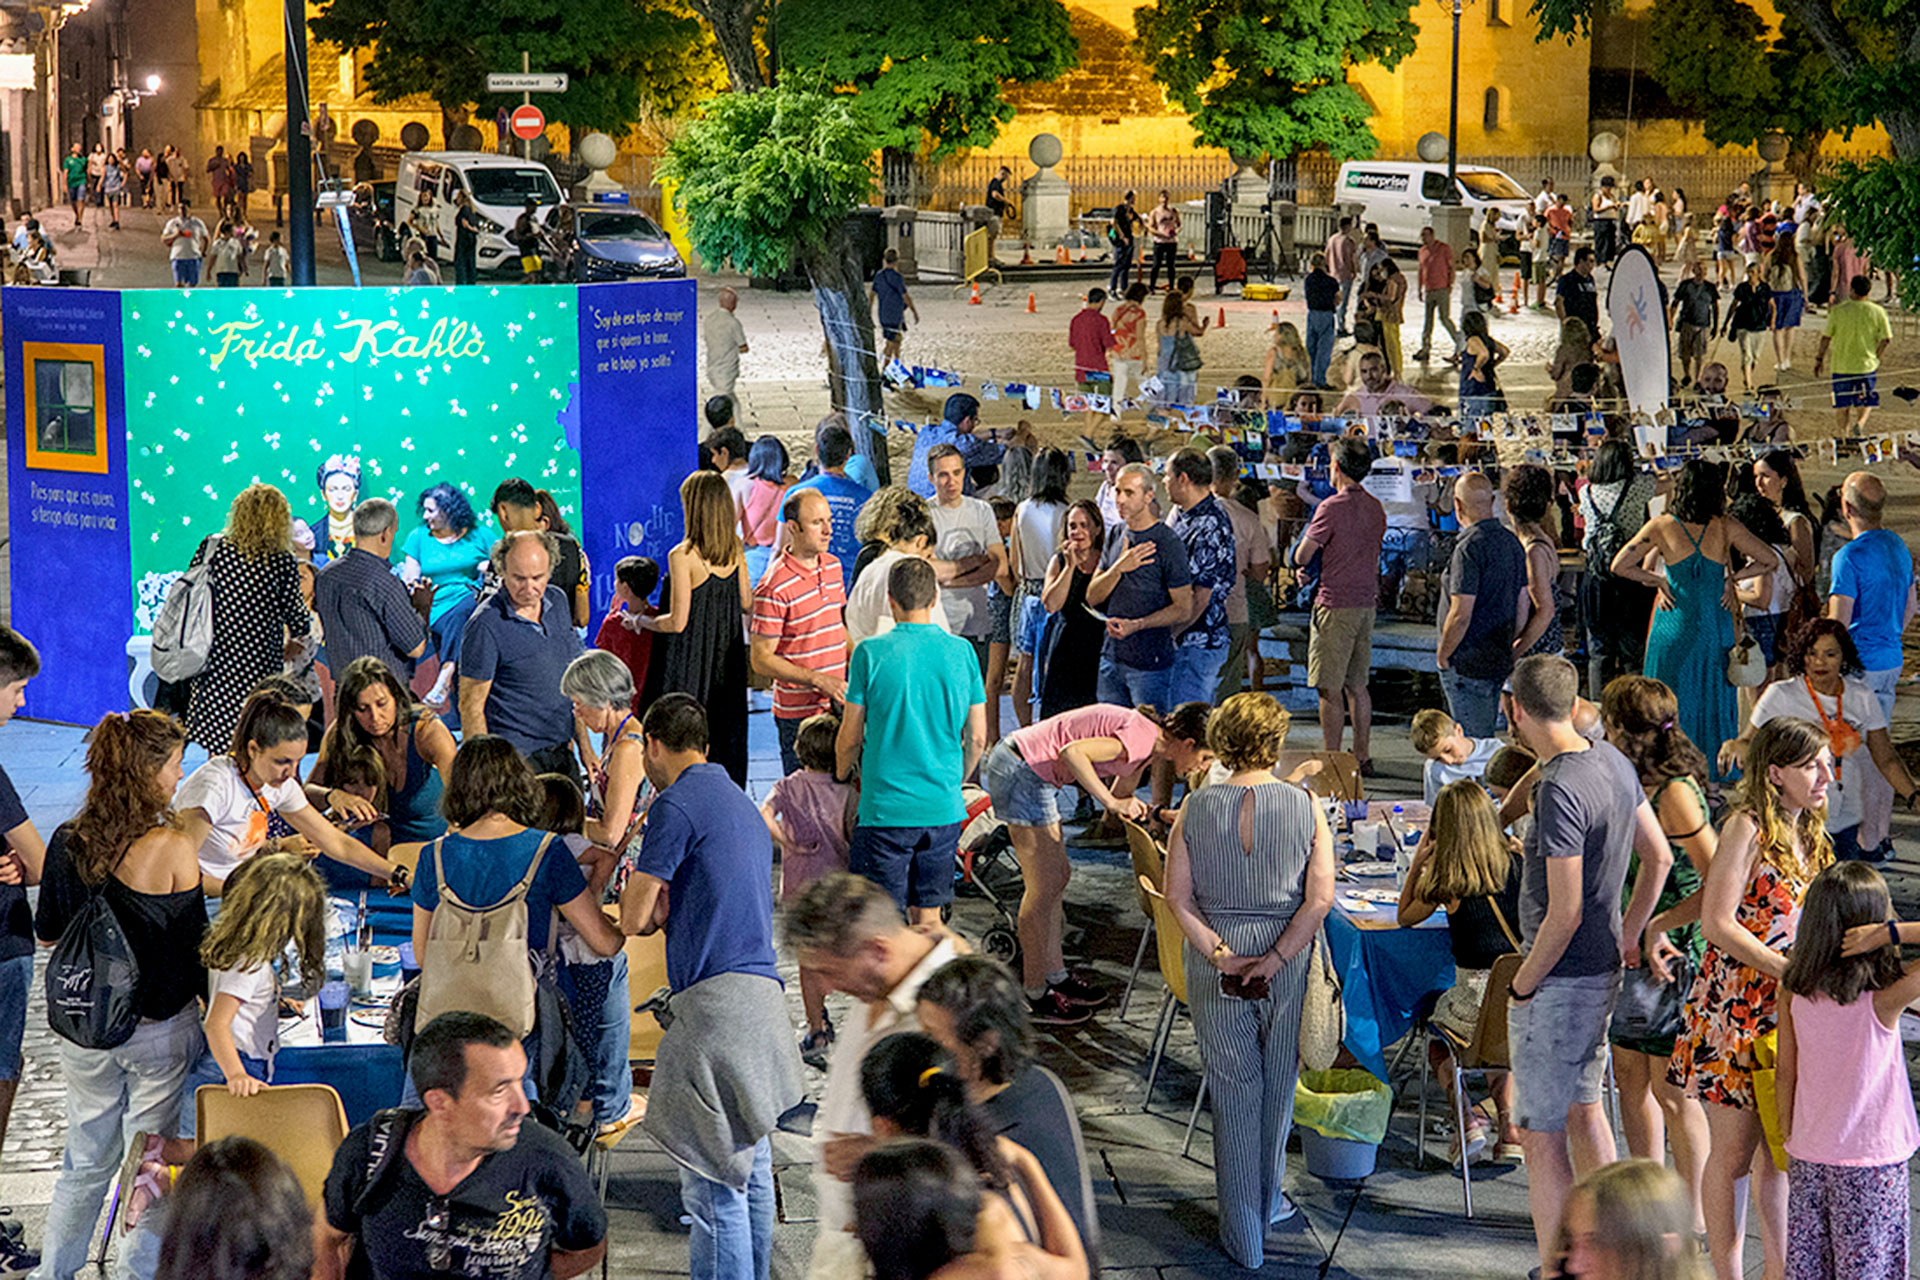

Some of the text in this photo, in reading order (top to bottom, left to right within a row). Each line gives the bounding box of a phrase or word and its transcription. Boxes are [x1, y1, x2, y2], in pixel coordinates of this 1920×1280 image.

[1347, 174, 1409, 188] enterprise
[636, 309, 651, 325] tipo
[653, 307, 663, 322] de
[208, 317, 485, 366] Frida Kahlo
